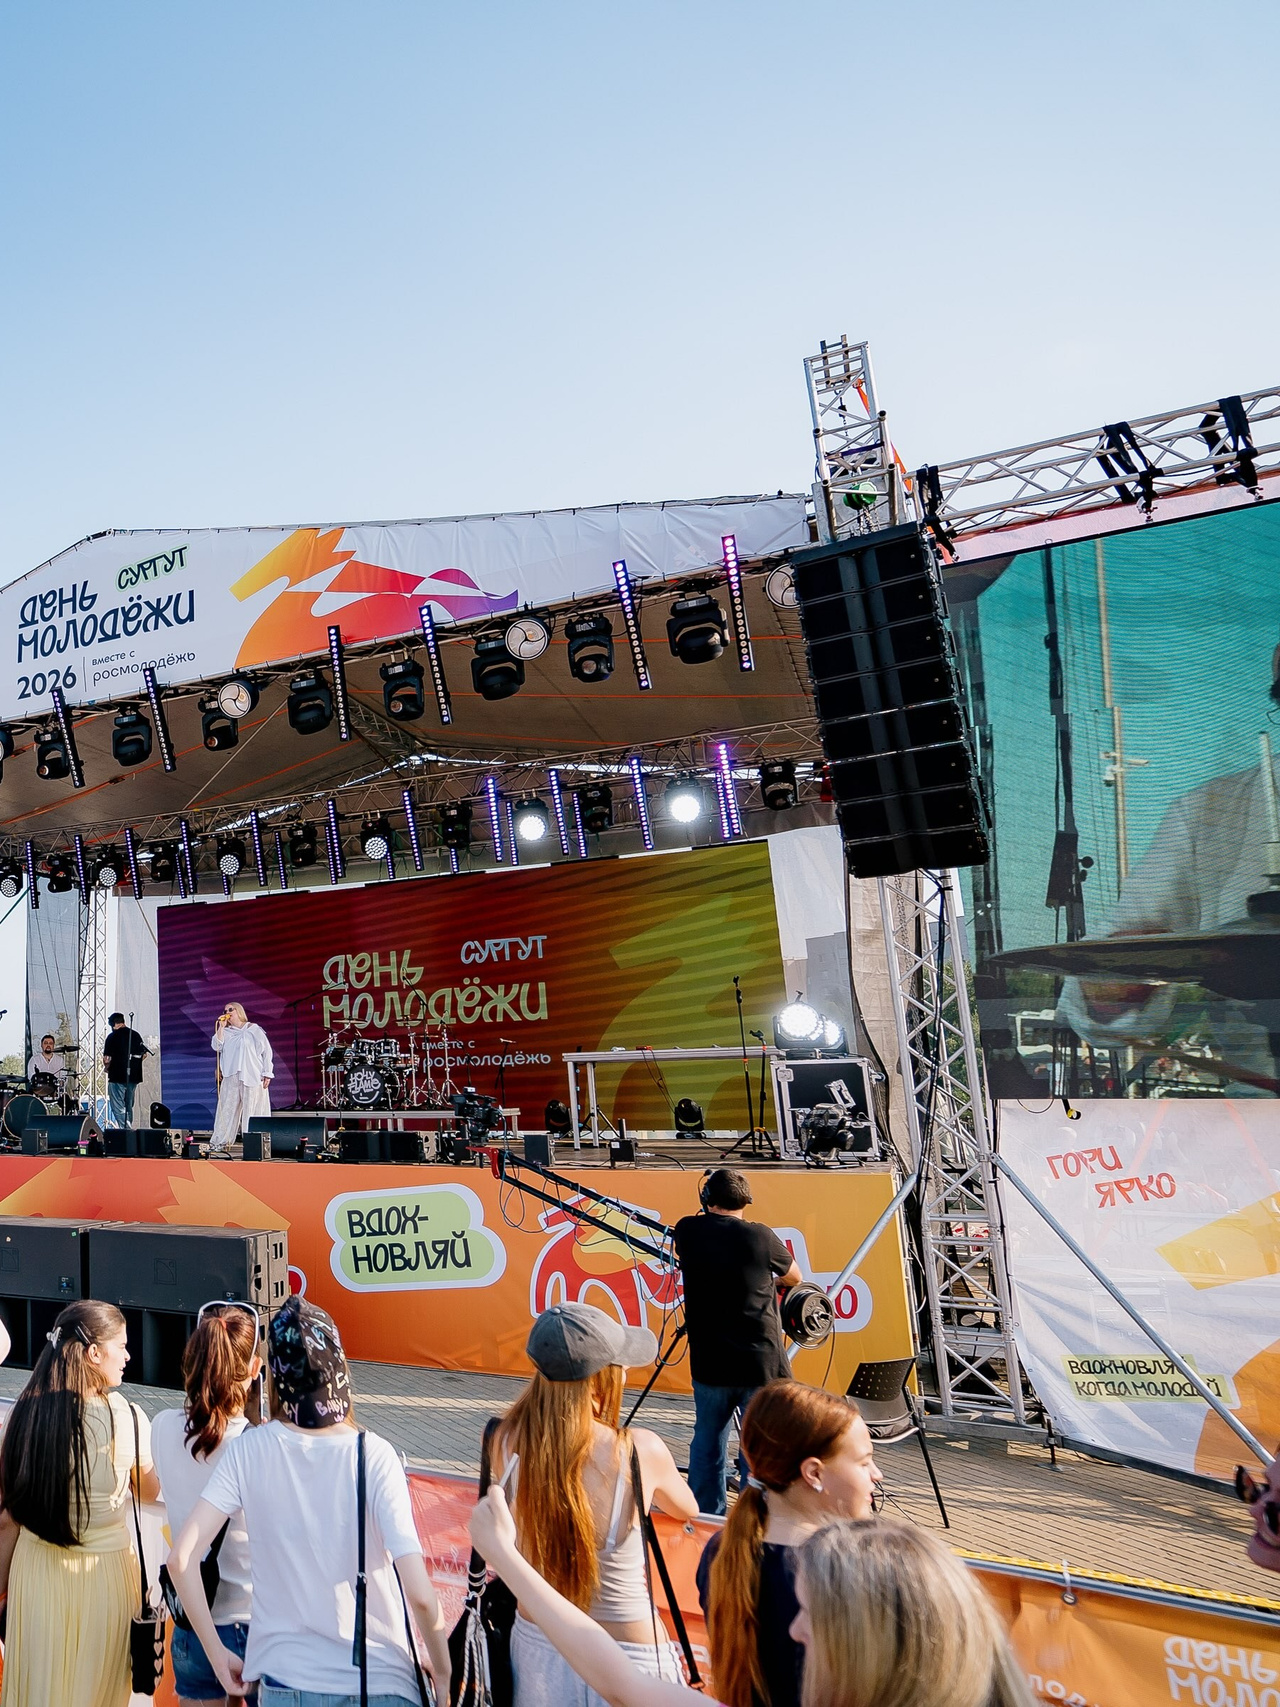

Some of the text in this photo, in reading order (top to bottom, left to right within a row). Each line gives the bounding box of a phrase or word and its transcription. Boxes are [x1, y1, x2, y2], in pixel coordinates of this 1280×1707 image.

[117, 546, 188, 590] СУРГУТ
[91, 652, 126, 666] вместе
[93, 650, 196, 687] росмолодёжь
[17, 665, 78, 700] 2026
[460, 935, 548, 965] СУРГУТ
[1046, 1145, 1124, 1180] ГОРИ
[1094, 1172, 1177, 1209] ЯРКО
[346, 1204, 429, 1239] ВДОХ-
[351, 1230, 472, 1274] НОВЛЯЙ
[1074, 1377, 1222, 1398] КОГДА МОЛОДЙ
